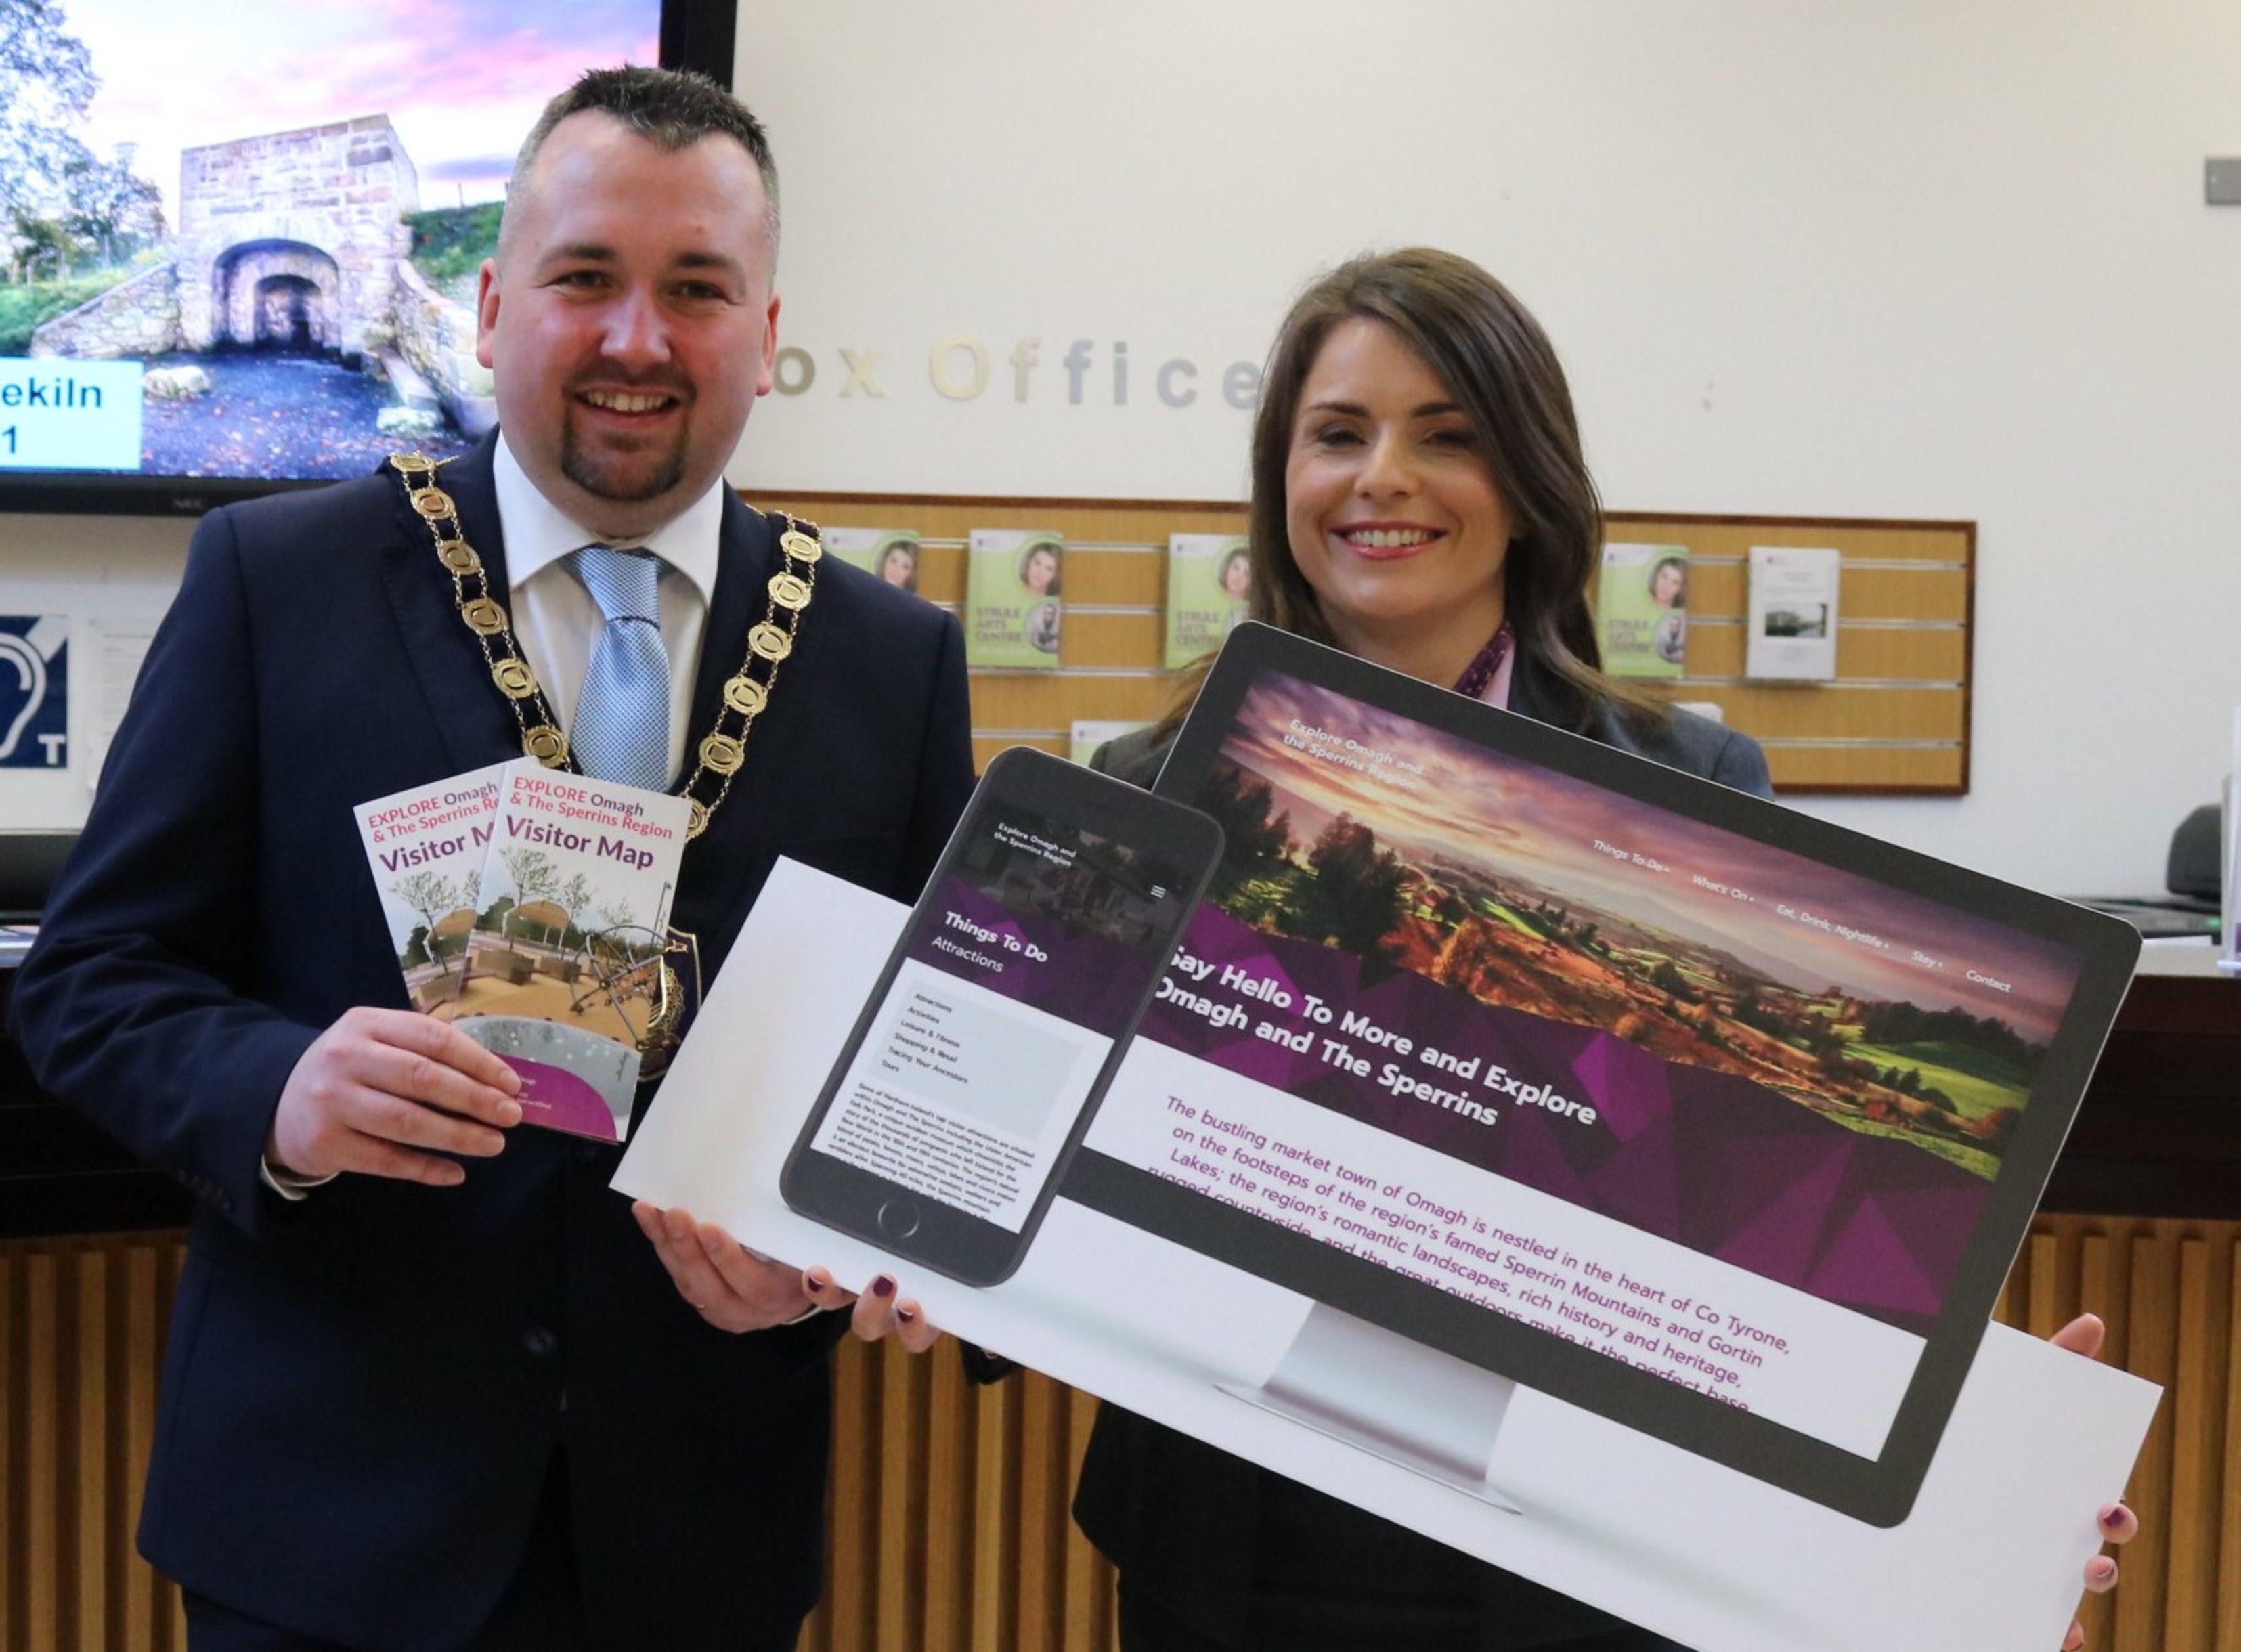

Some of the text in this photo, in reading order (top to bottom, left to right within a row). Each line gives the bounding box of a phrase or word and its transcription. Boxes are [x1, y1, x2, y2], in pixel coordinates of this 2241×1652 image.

[774, 334, 1261, 410] ox Office
[1, 377, 102, 408] ekiln
[38, 734, 66, 765] T
[1284, 735, 1306, 749] the
[1309, 743, 1365, 771] Sperrins
[1290, 718, 1424, 776] Explore Omagh and
[368, 796, 441, 829] EXPLORE
[443, 781, 498, 805] Omagh
[510, 791, 521, 804] &
[527, 794, 554, 811] The
[558, 801, 618, 827] Sperrins
[622, 816, 673, 839] Region
[513, 776, 644, 817] EXPLORE Omagh
[374, 806, 481, 843] & The Sperrins
[506, 814, 591, 852] Visitor
[596, 835, 654, 871] Map
[998, 822, 1077, 858] Explore Omagh and
[378, 835, 466, 873] Visitor
[993, 831, 1072, 867] the Sperrins Region
[1593, 839, 1663, 872] Things To Do
[1693, 874, 1748, 901] What's On
[932, 936, 1003, 972] Attractions
[945, 911, 1047, 962] Things To Do
[1835, 923, 1883, 949] Nightlife
[1911, 951, 1937, 969] Stay
[1965, 970, 2012, 993] Contact
[914, 993, 952, 1013] Attractions
[1219, 964, 1292, 1007] Hello
[1303, 994, 1332, 1024] To
[1339, 1010, 1412, 1055] More
[1420, 1047, 1481, 1079] and
[1484, 1065, 1596, 1124] Explore
[1255, 1021, 1314, 1053] and
[1321, 1039, 1371, 1077] The
[1378, 1064, 1497, 1125] Sperrins
[1167, 1095, 1789, 1354] The bustling market town of Omagh is nestled in the heart of Co Tyrone,
[1172, 1127, 1762, 1367] on the footsteps of the region's famed Sperrin Mountains and Gortin
[1170, 1148, 1740, 1387] Lakes; the region's romantic landscapes, rich history and heritage,
